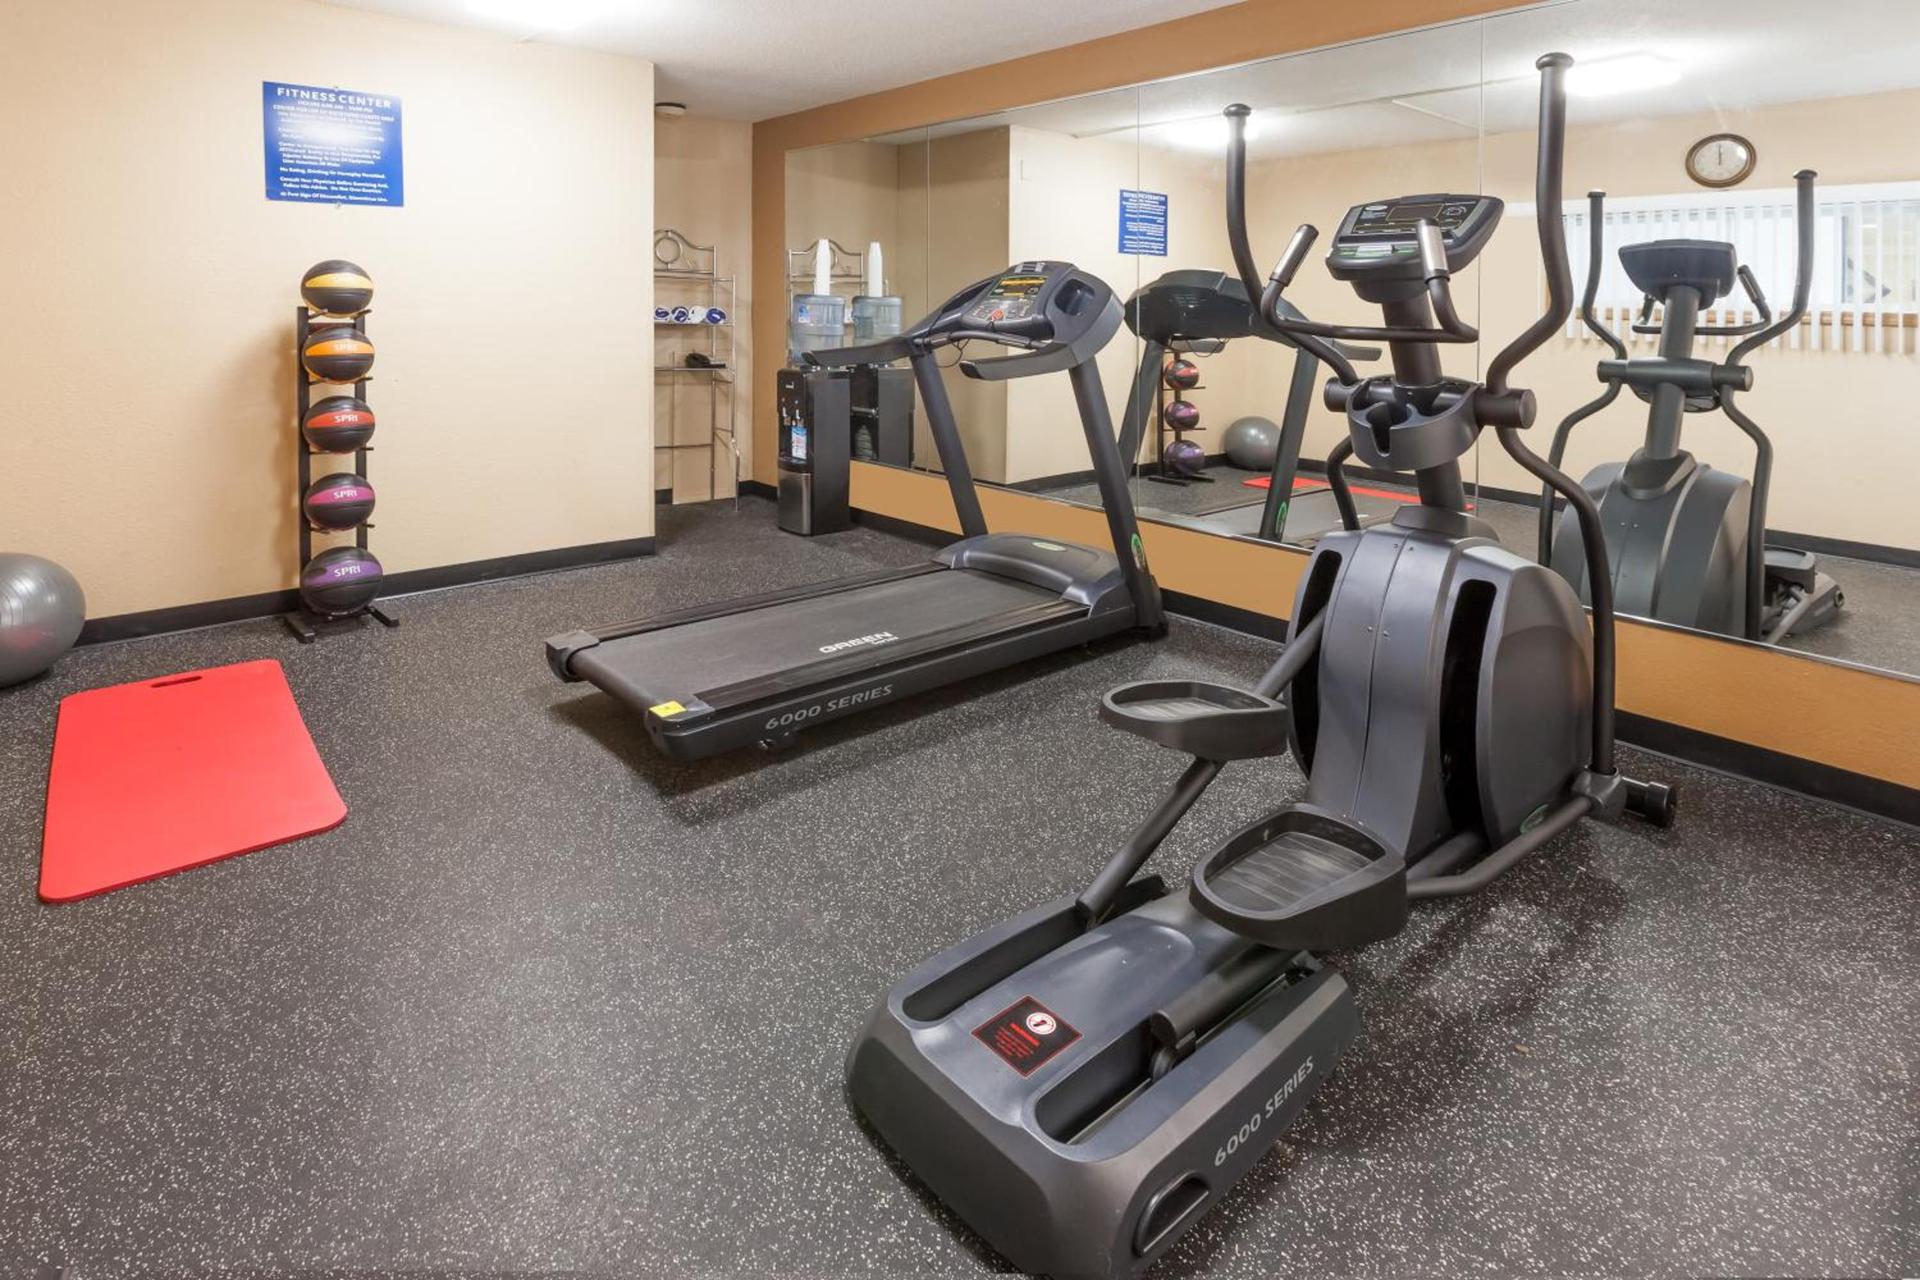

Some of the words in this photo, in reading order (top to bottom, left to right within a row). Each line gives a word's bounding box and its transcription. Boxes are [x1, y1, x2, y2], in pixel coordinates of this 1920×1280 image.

[277, 87, 336, 102] FITNESS
[339, 94, 391, 108] CENTER
[334, 415, 358, 424] SPRI
[333, 489, 358, 499] SPRI
[334, 565, 361, 577] SPRI
[765, 705, 822, 730] 6000
[826, 683, 894, 712] SERIES
[1214, 1113, 1262, 1167] 6000
[1265, 1055, 1314, 1119] SERIES
